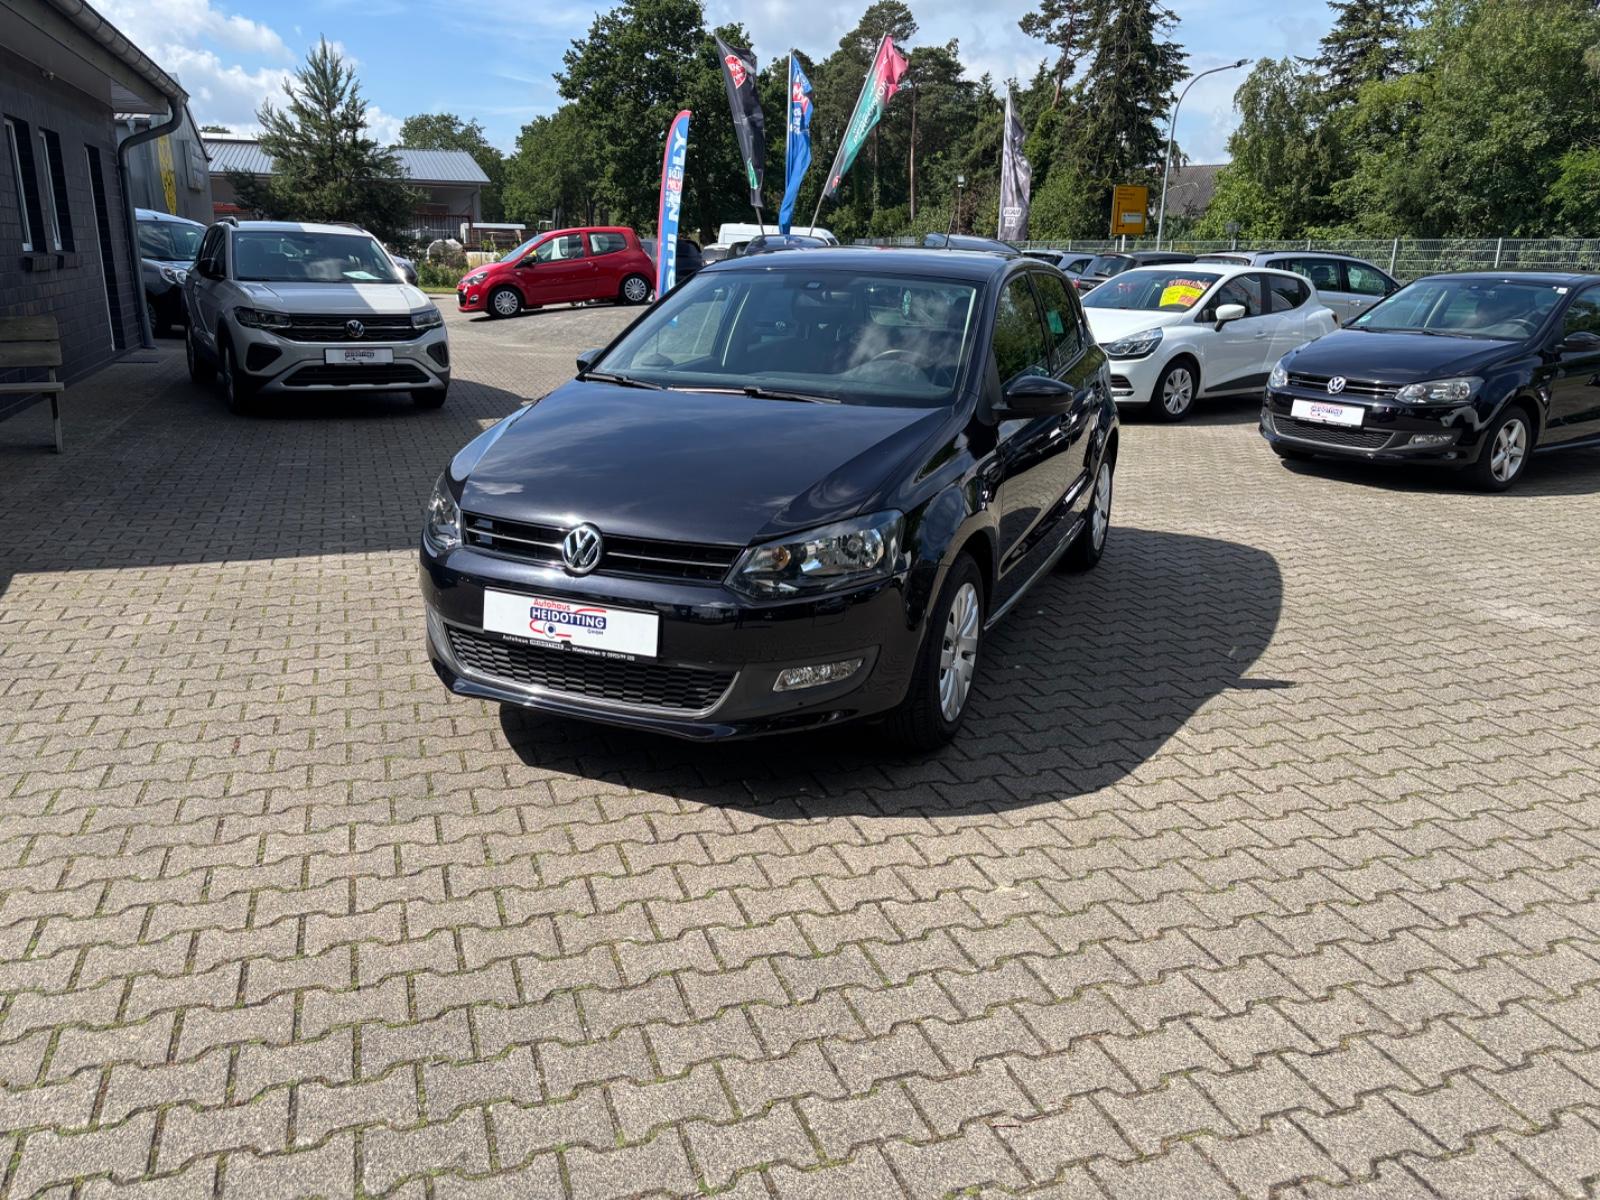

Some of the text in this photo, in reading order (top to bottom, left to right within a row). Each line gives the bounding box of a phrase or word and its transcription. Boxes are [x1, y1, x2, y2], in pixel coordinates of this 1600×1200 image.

[533, 598, 571, 611] Autohaus
[532, 607, 605, 628] HEIDOTTING
[586, 628, 604, 636] GmbH
